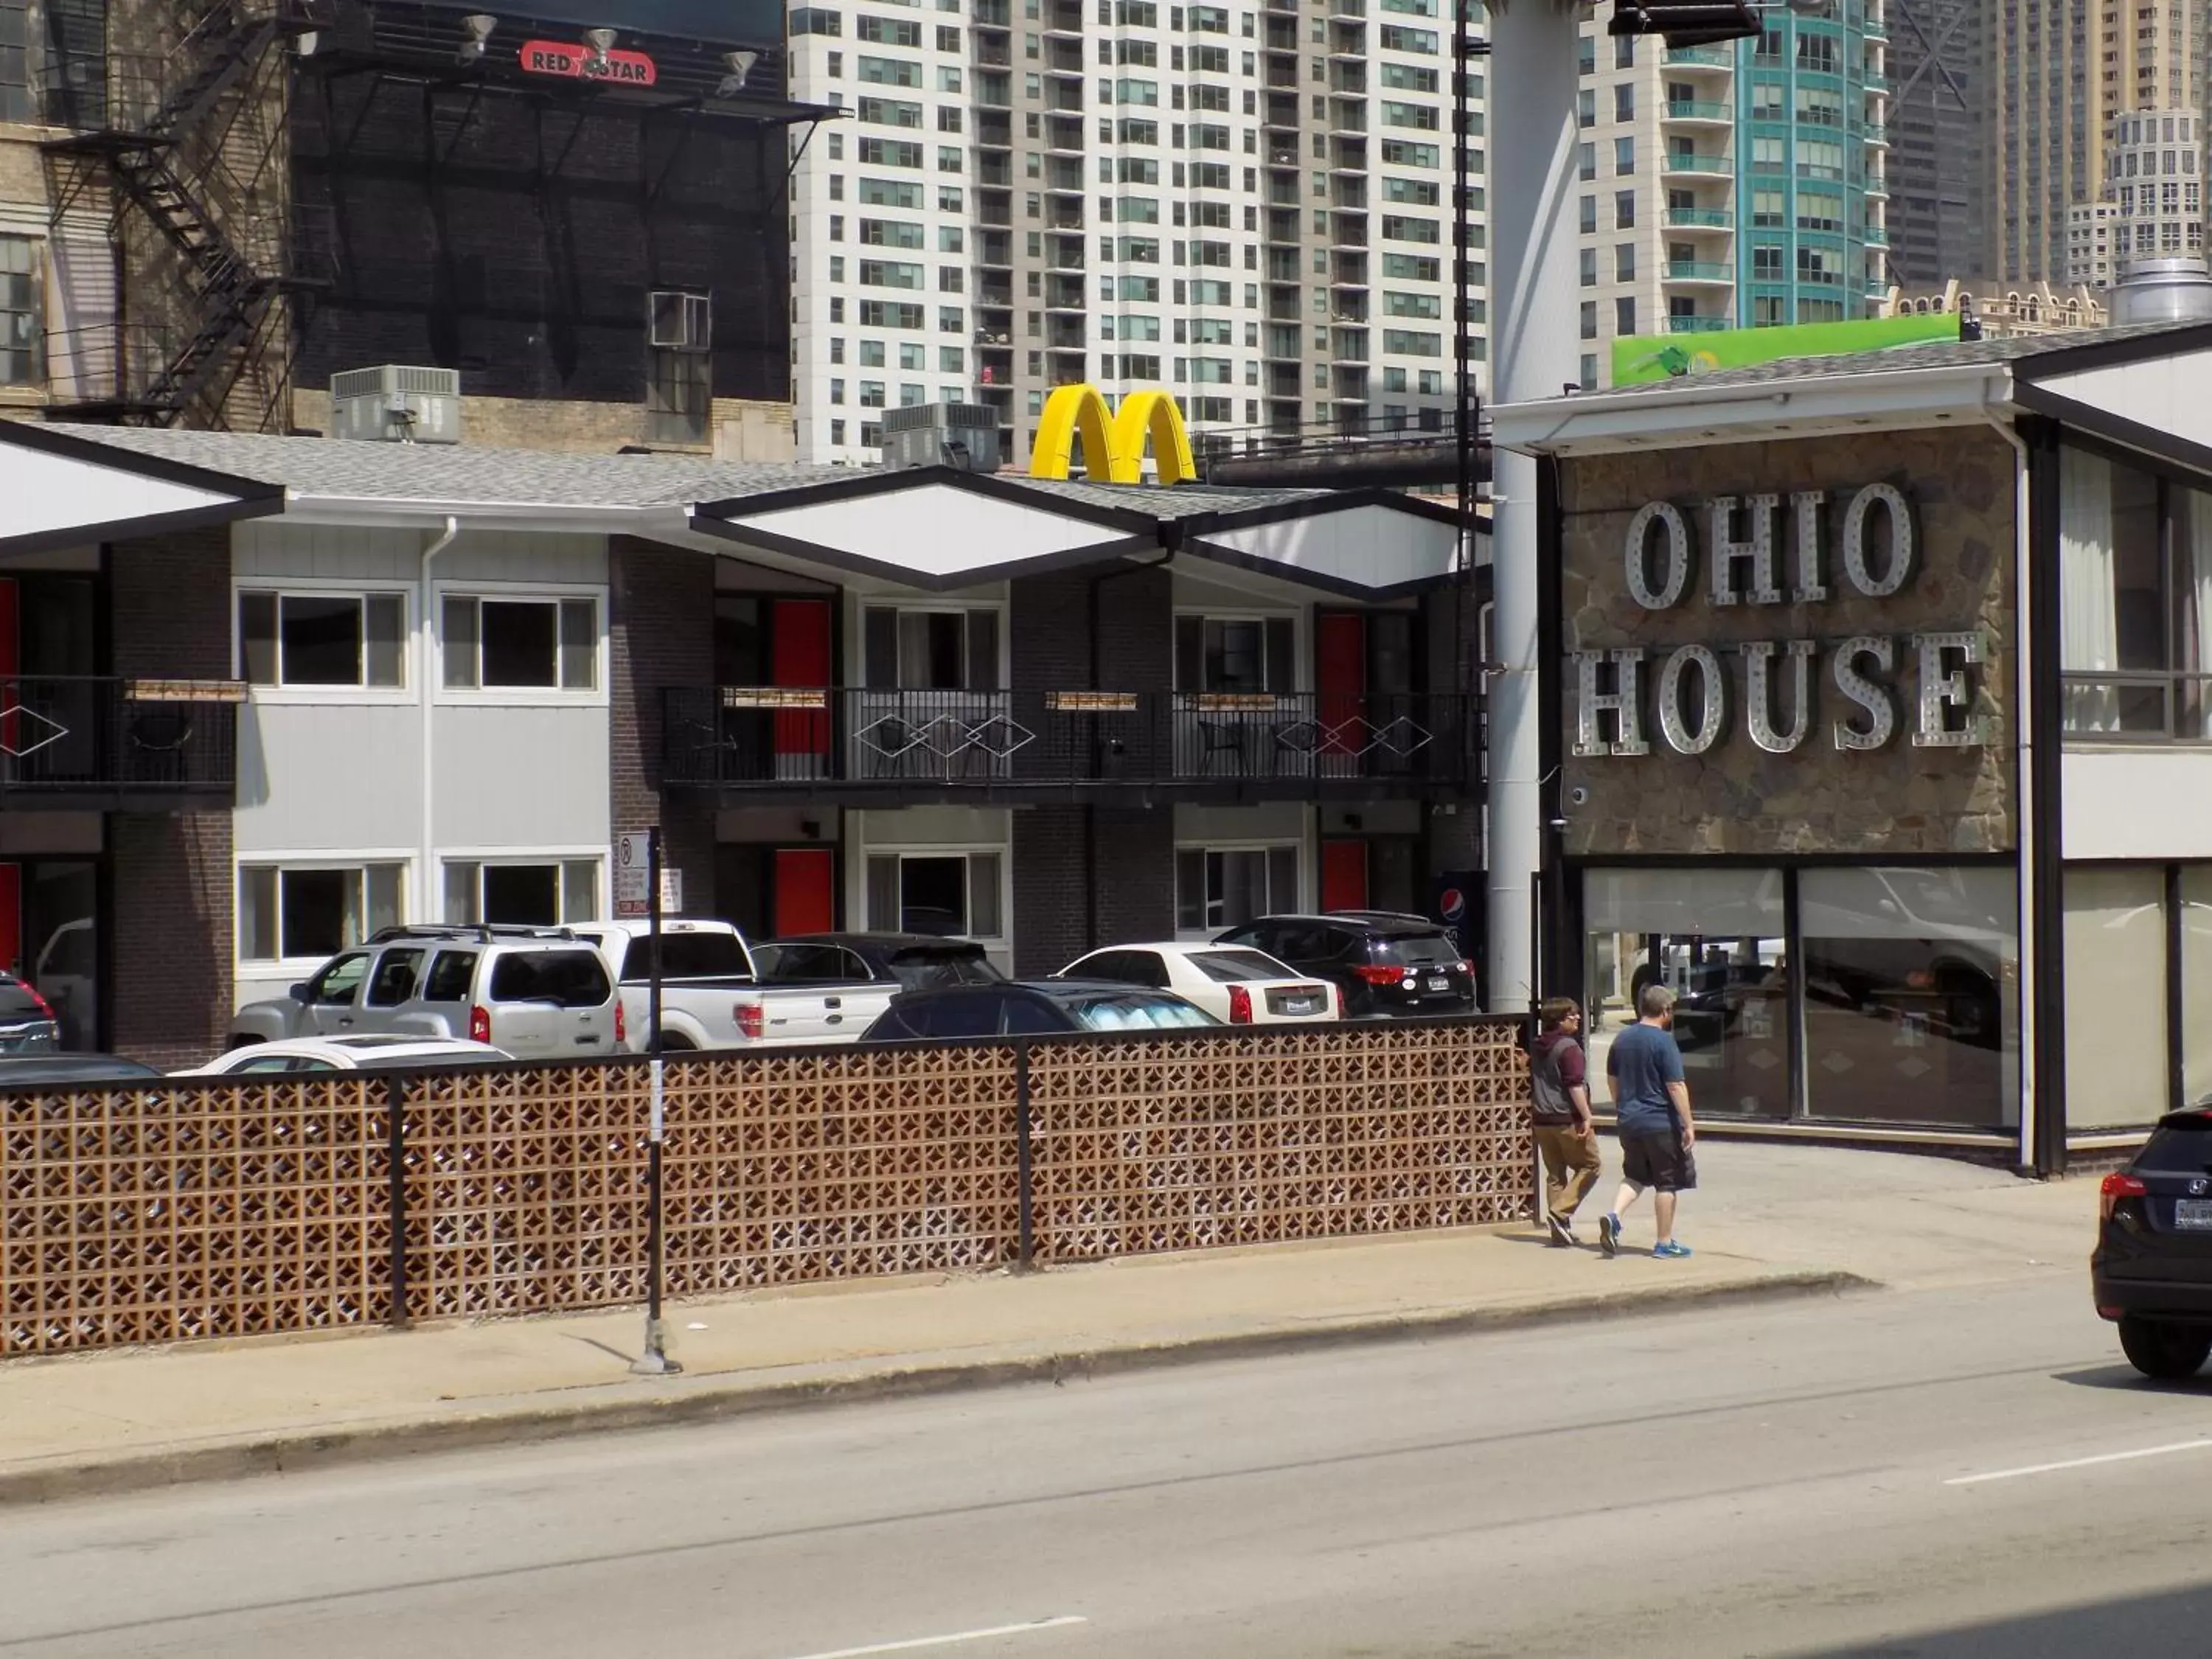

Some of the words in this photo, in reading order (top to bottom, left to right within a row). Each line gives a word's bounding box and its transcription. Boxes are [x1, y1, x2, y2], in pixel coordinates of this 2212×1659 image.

[532, 52, 571, 72] RED
[1624, 483, 1913, 610] OHIO
[1571, 632, 1989, 756] HOUSE
